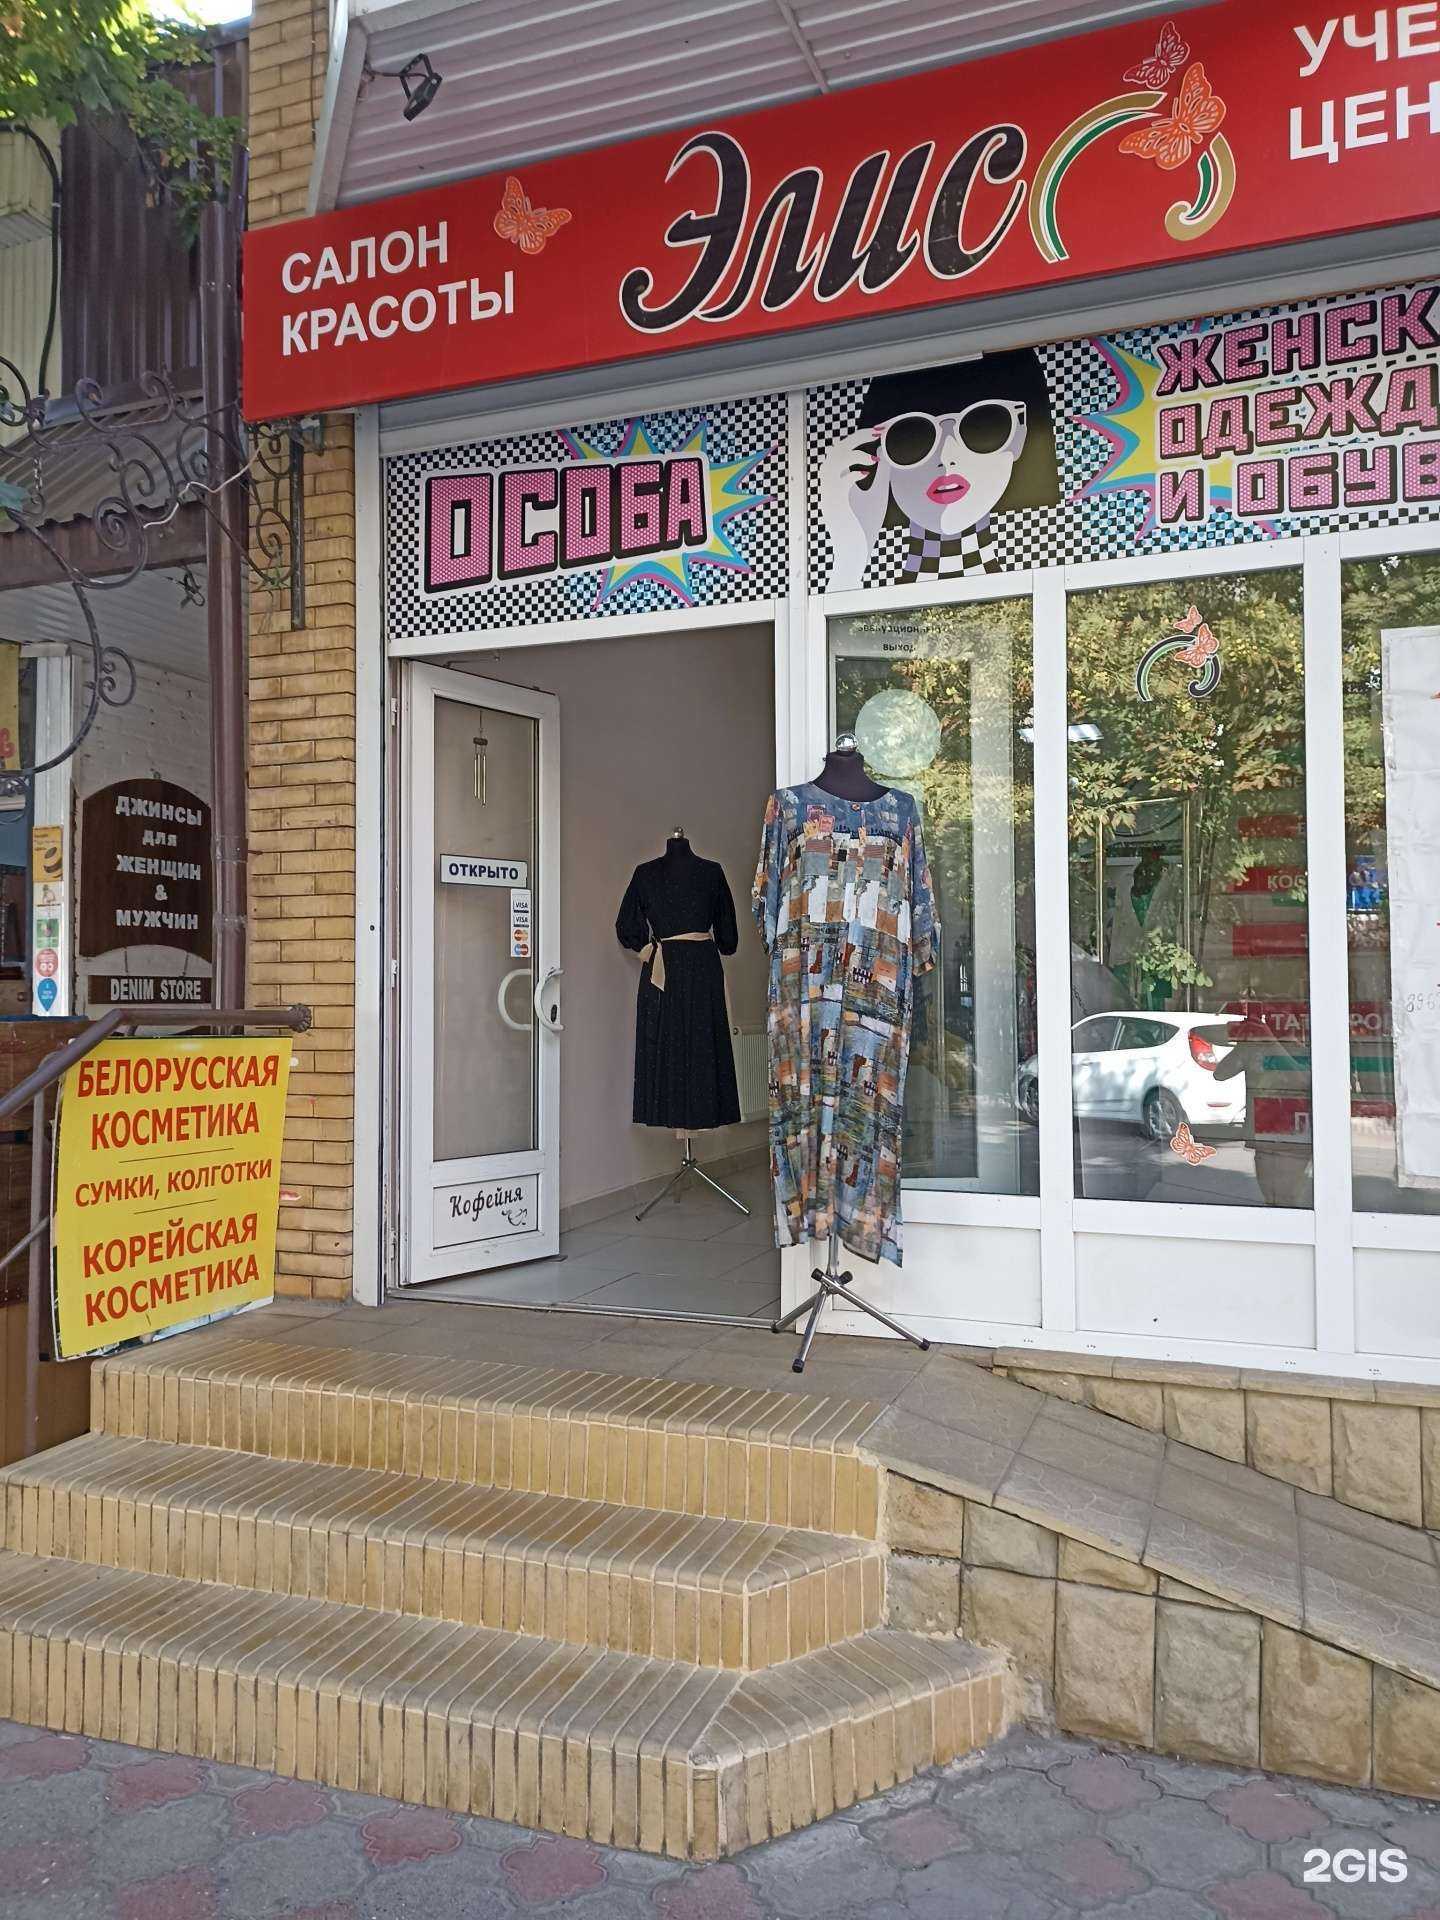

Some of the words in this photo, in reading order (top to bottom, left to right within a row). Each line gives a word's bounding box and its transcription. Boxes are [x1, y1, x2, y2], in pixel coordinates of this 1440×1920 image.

[1293, 2, 1440, 77] УЧЕ
[1289, 79, 1440, 164] ЦЕН
[619, 123, 1027, 334] Элис
[281, 221, 448, 294] САЛОН
[281, 270, 515, 356] КРАСОТЫ
[1156, 286, 1440, 398] ЖЕНСК
[1160, 363, 1440, 460] ОДЕЖД
[1159, 467, 1205, 525] И
[1236, 440, 1440, 520] ОБУВ
[424, 456, 709, 595] ОСОБА
[115, 795, 203, 826] ДЖИНСЫ
[116, 854, 201, 881] ЖЕНЩИН
[155, 884, 168, 901] &
[448, 863, 519, 880] ОТКРЫТО
[116, 909, 199, 930] МУЖЧИН
[515, 901, 528, 909] VISA
[110, 978, 154, 1001] DENIM
[160, 979, 201, 1000] STORE
[78, 1055, 280, 1098] БЕЛОРУССКАЯ
[91, 1102, 260, 1150] КОСМЕТИКА
[75, 1174, 160, 1207] СУМКИ,
[167, 1159, 272, 1193] КОЛГОТКИ
[449, 1186, 523, 1222] Кофейня
[83, 1213, 258, 1278] КОРЕЙСКАЯ
[85, 1254, 260, 1327] КОСМЕТИКА
